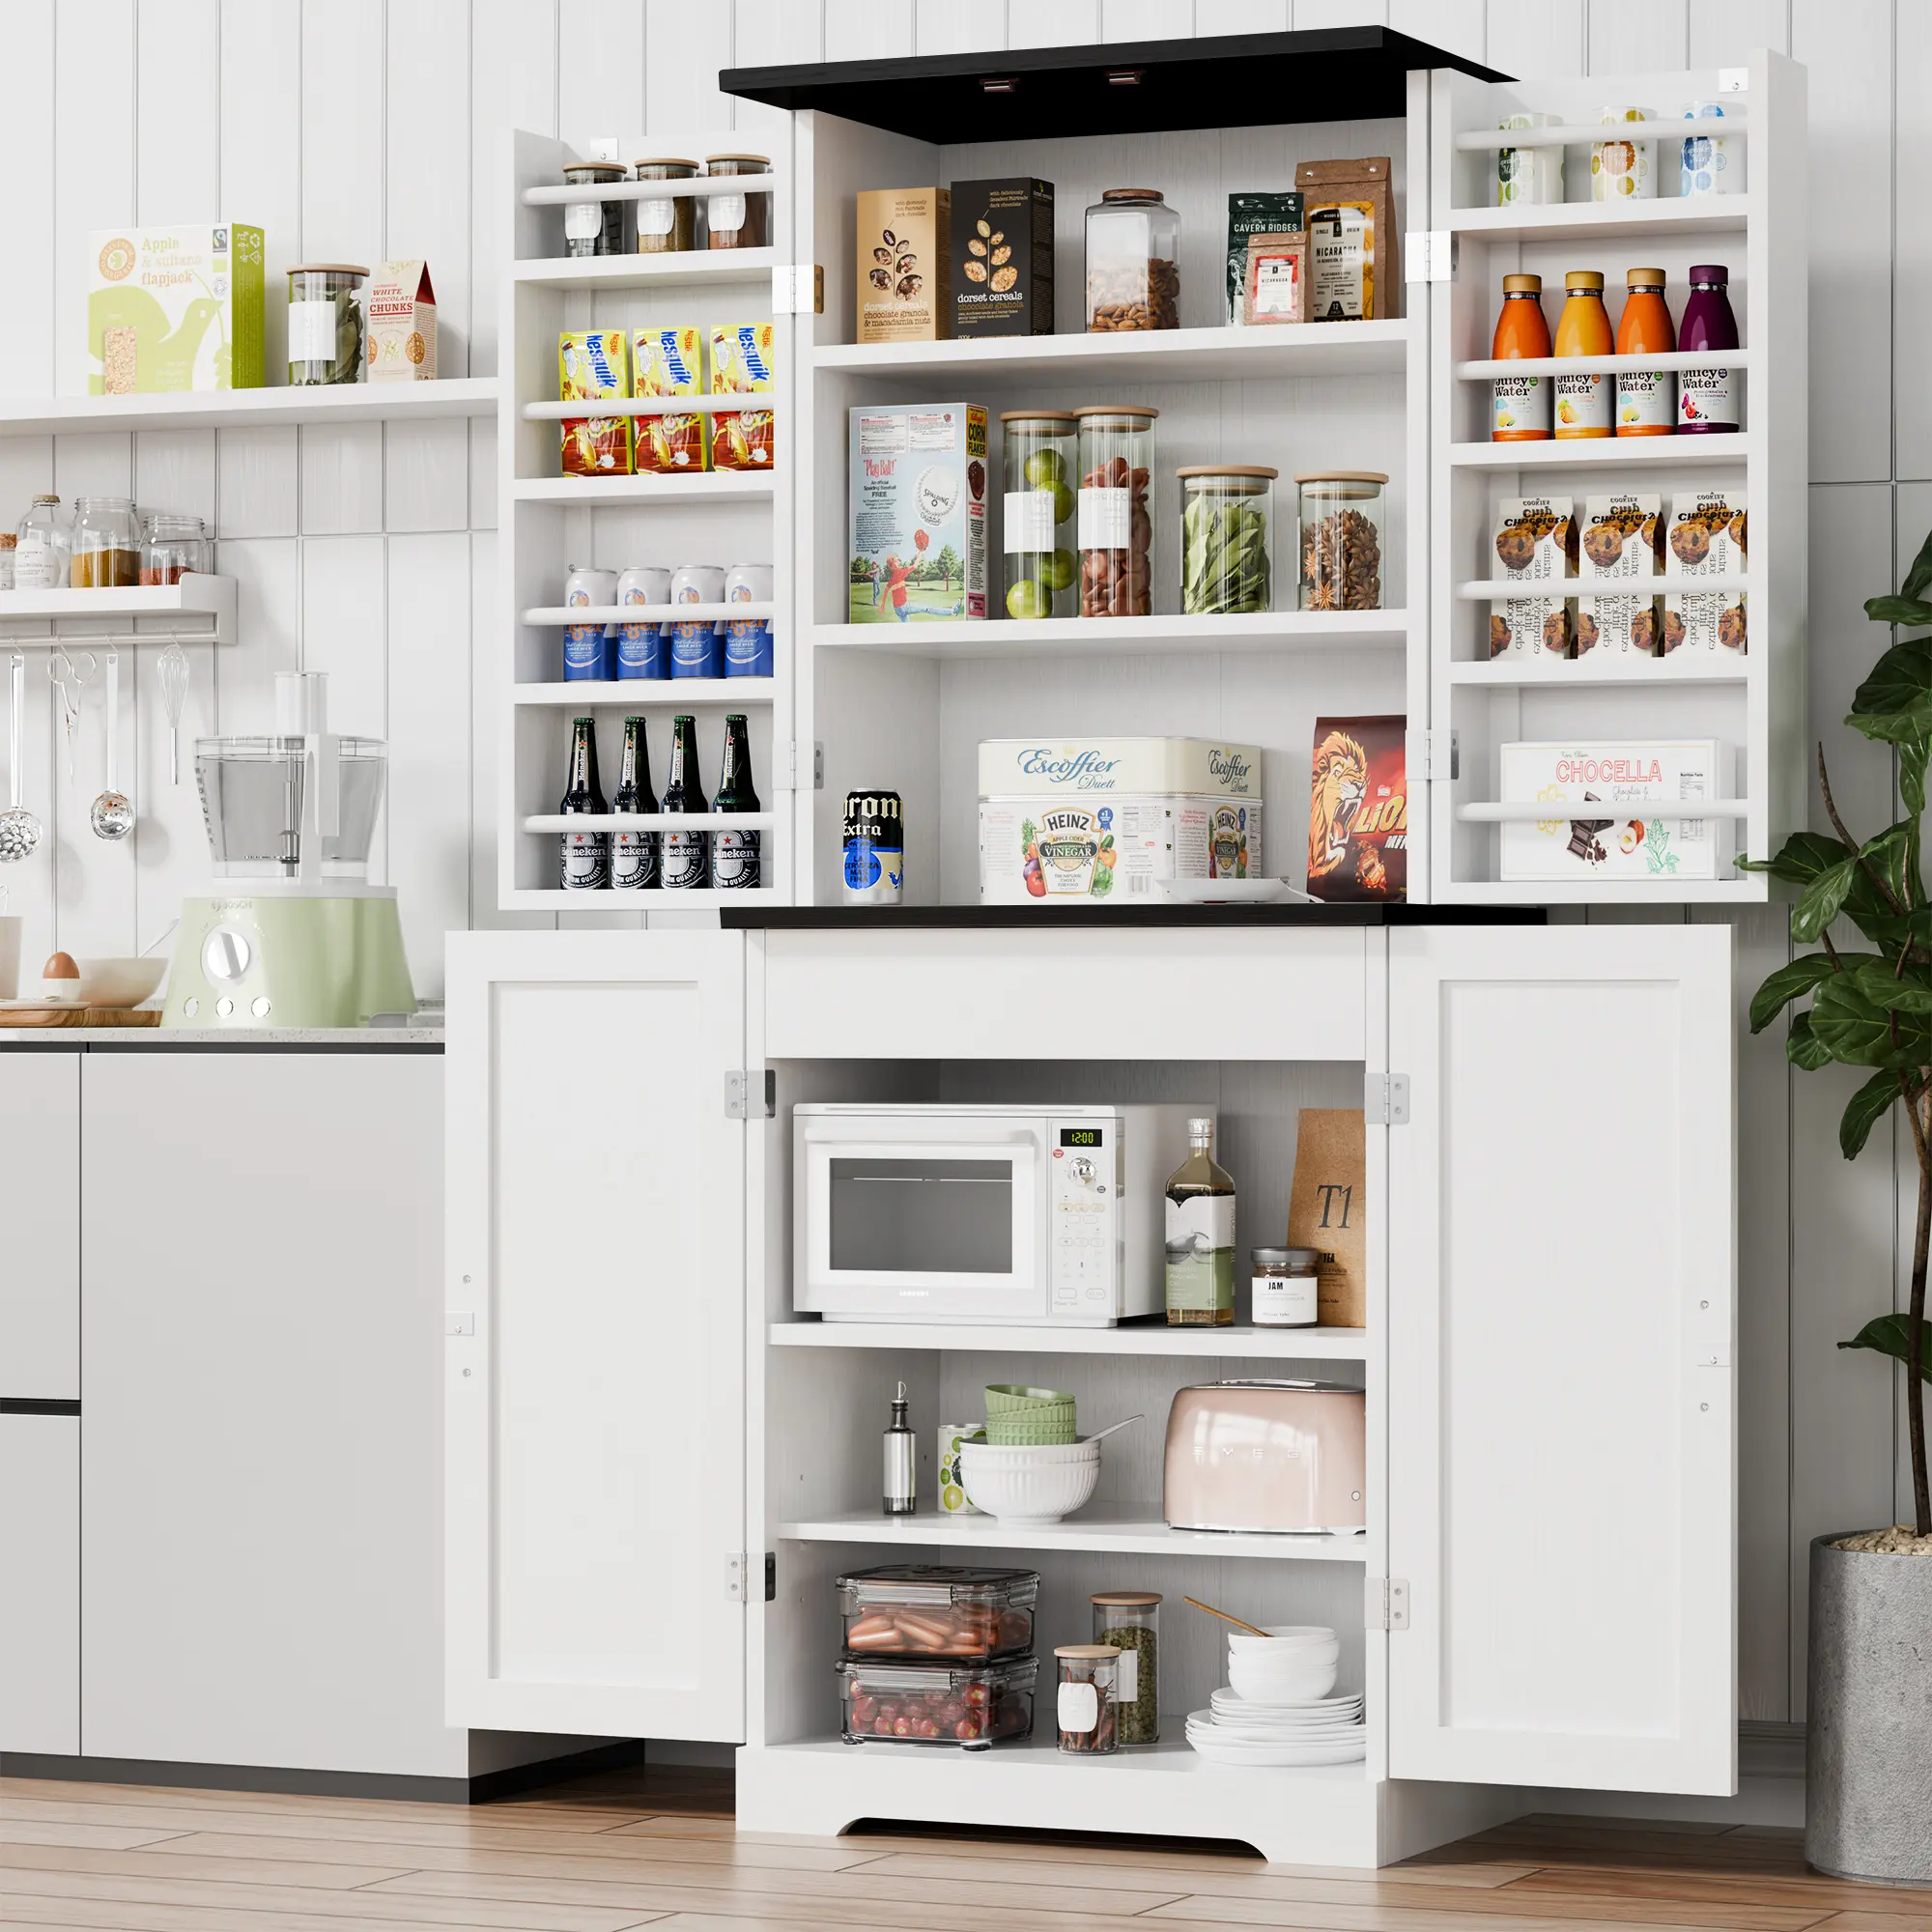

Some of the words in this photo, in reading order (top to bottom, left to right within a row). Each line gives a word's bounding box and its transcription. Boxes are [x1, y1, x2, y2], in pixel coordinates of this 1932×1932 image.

[1234, 223, 1265, 233] CAVERN
[1267, 223, 1297, 232] RIDGES
[141, 236, 180, 253] Apple
[141, 269, 193, 288] flapjack
[370, 295, 414, 303] CHOCOLATE
[957, 293, 988, 303] dorset
[988, 291, 1023, 301] cereals
[369, 302, 413, 313] CHUNKS
[864, 310, 899, 320] chocolate
[900, 309, 929, 319] granola
[871, 318, 914, 327] macadamia
[585, 334, 618, 388] Nesquik
[660, 330, 693, 385] Nesquik
[737, 327, 771, 383] Nesquik
[1494, 385, 1531, 397] Water
[1556, 384, 1593, 395] Water
[1619, 382, 1656, 392] Water
[1682, 379, 1720, 389] Water
[923, 488, 950, 507] SPALDING
[1017, 748, 1122, 783] Escoffier
[1208, 748, 1251, 785] Escoffier
[1555, 759, 1662, 783] CHOCELLA
[1077, 773, 1116, 789] Duett
[1047, 813, 1090, 832] HEINZ
[1217, 812, 1236, 830] HEINZ
[1045, 848, 1092, 857] VINEGAR
[581, 867, 602, 883] QUALITY
[625, 865, 646, 882] QUALITY
[675, 865, 697, 883] QUALITY
[729, 868, 752, 886] QUALITY
[1071, 1132, 1094, 1144] 12:00
[1316, 1184, 1353, 1229] T1
[1322, 1253, 1335, 1264] TEA
[1267, 1281, 1284, 1291] JAM
